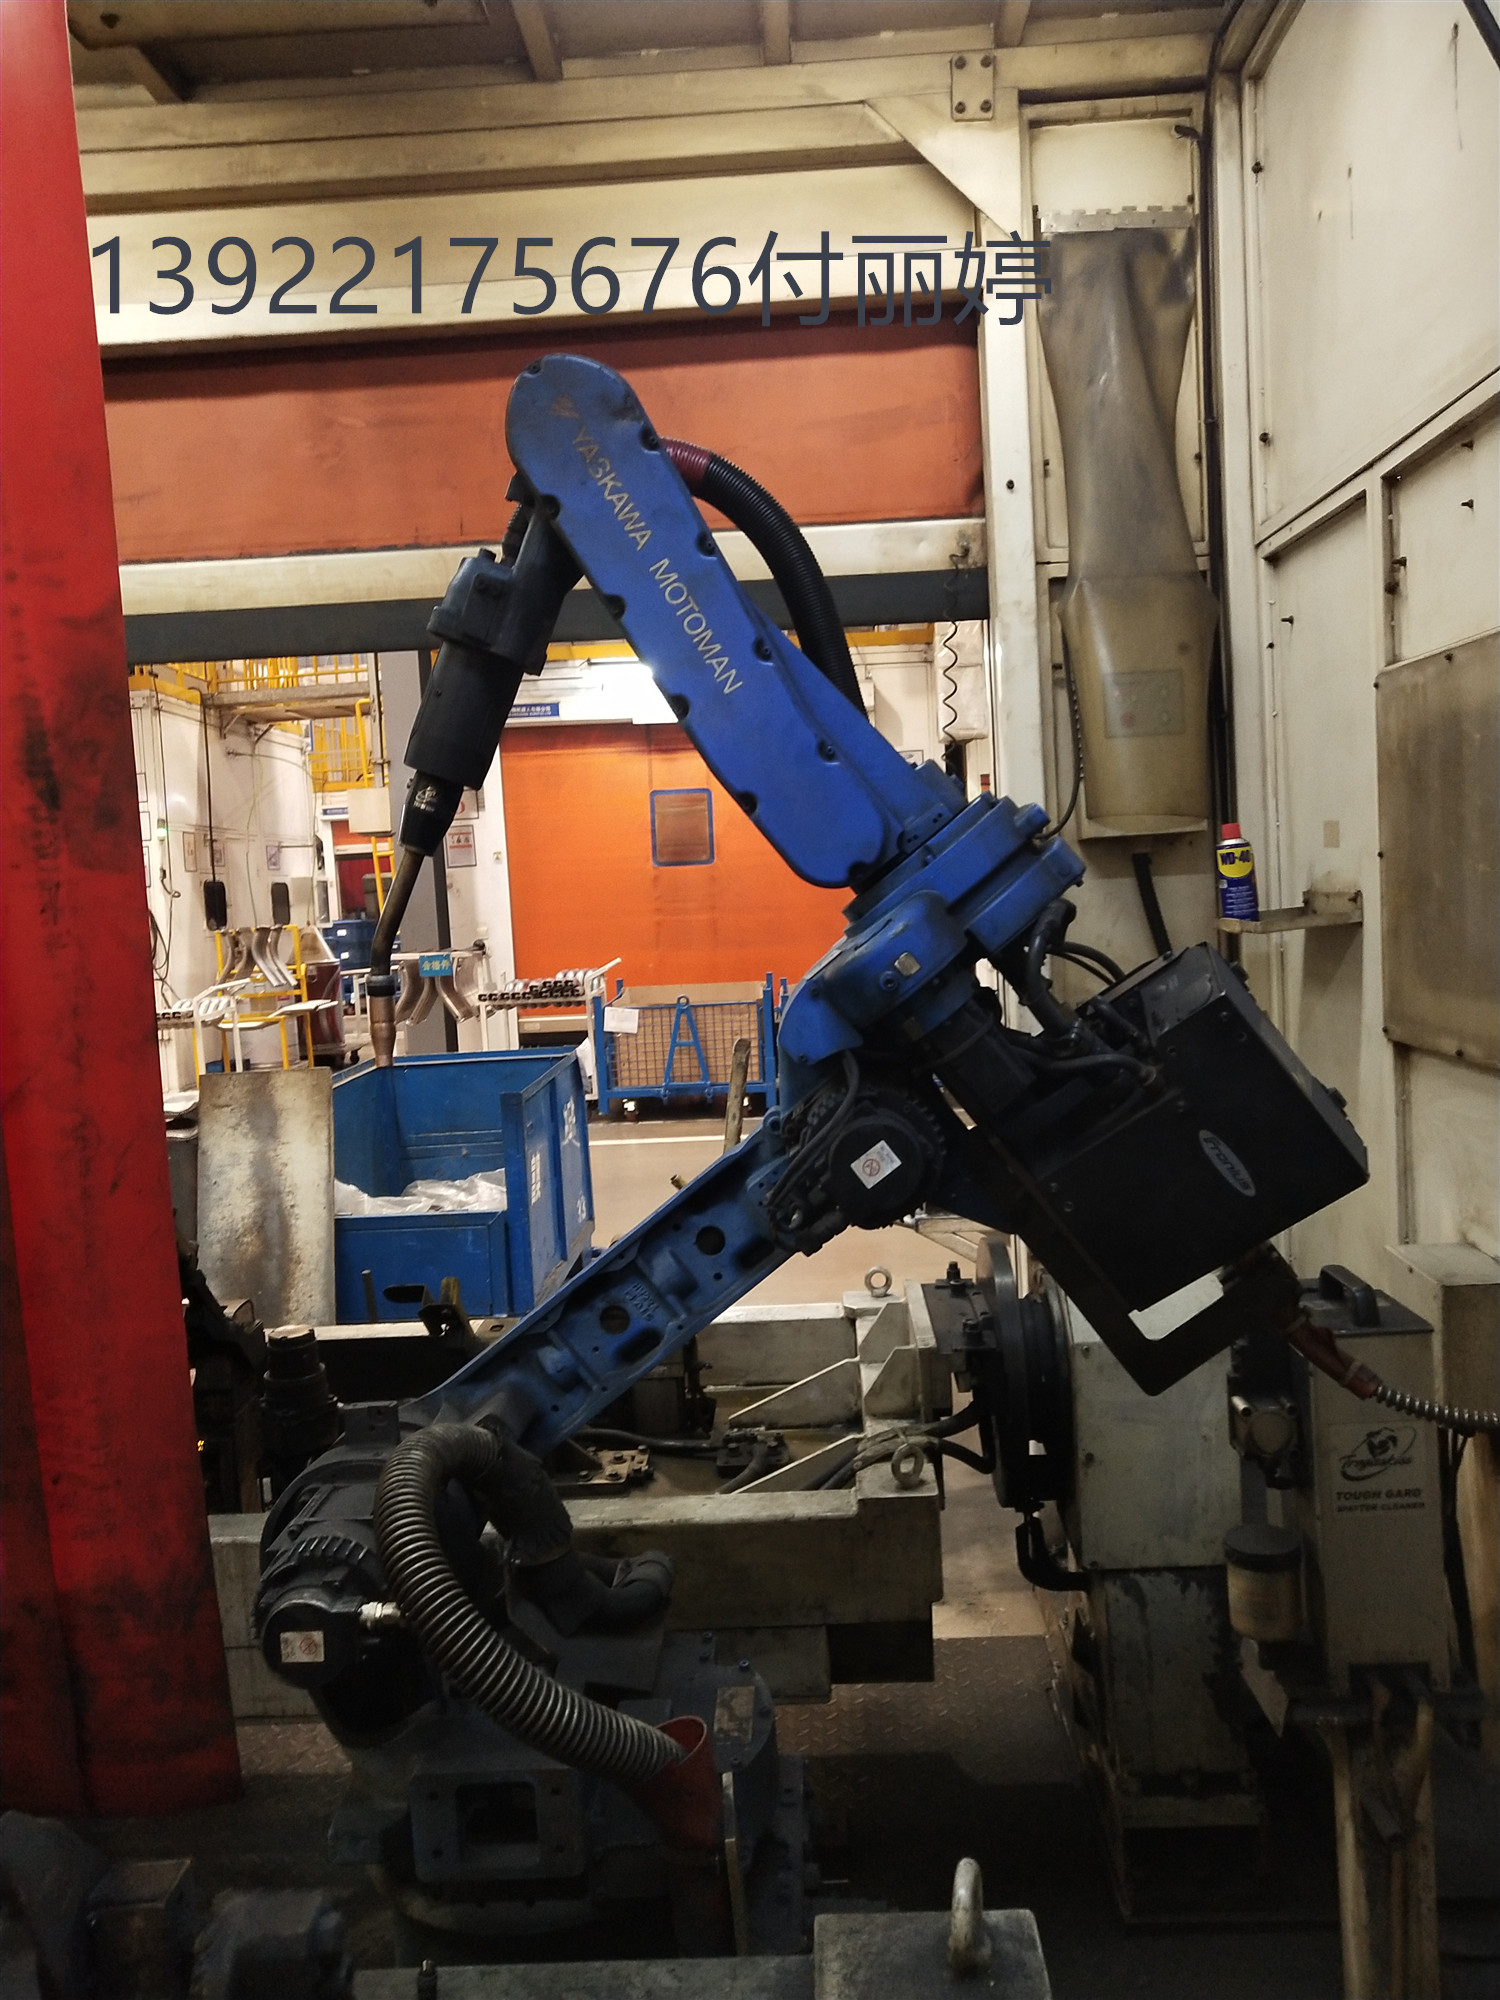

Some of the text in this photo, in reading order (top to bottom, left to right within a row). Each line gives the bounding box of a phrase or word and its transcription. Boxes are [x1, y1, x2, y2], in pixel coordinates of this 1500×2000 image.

[571, 424, 744, 696] YASKAWA MOTOMAN
[1220, 849, 1251, 866] WD-40
[1336, 1490, 1381, 1500] TOUGH
